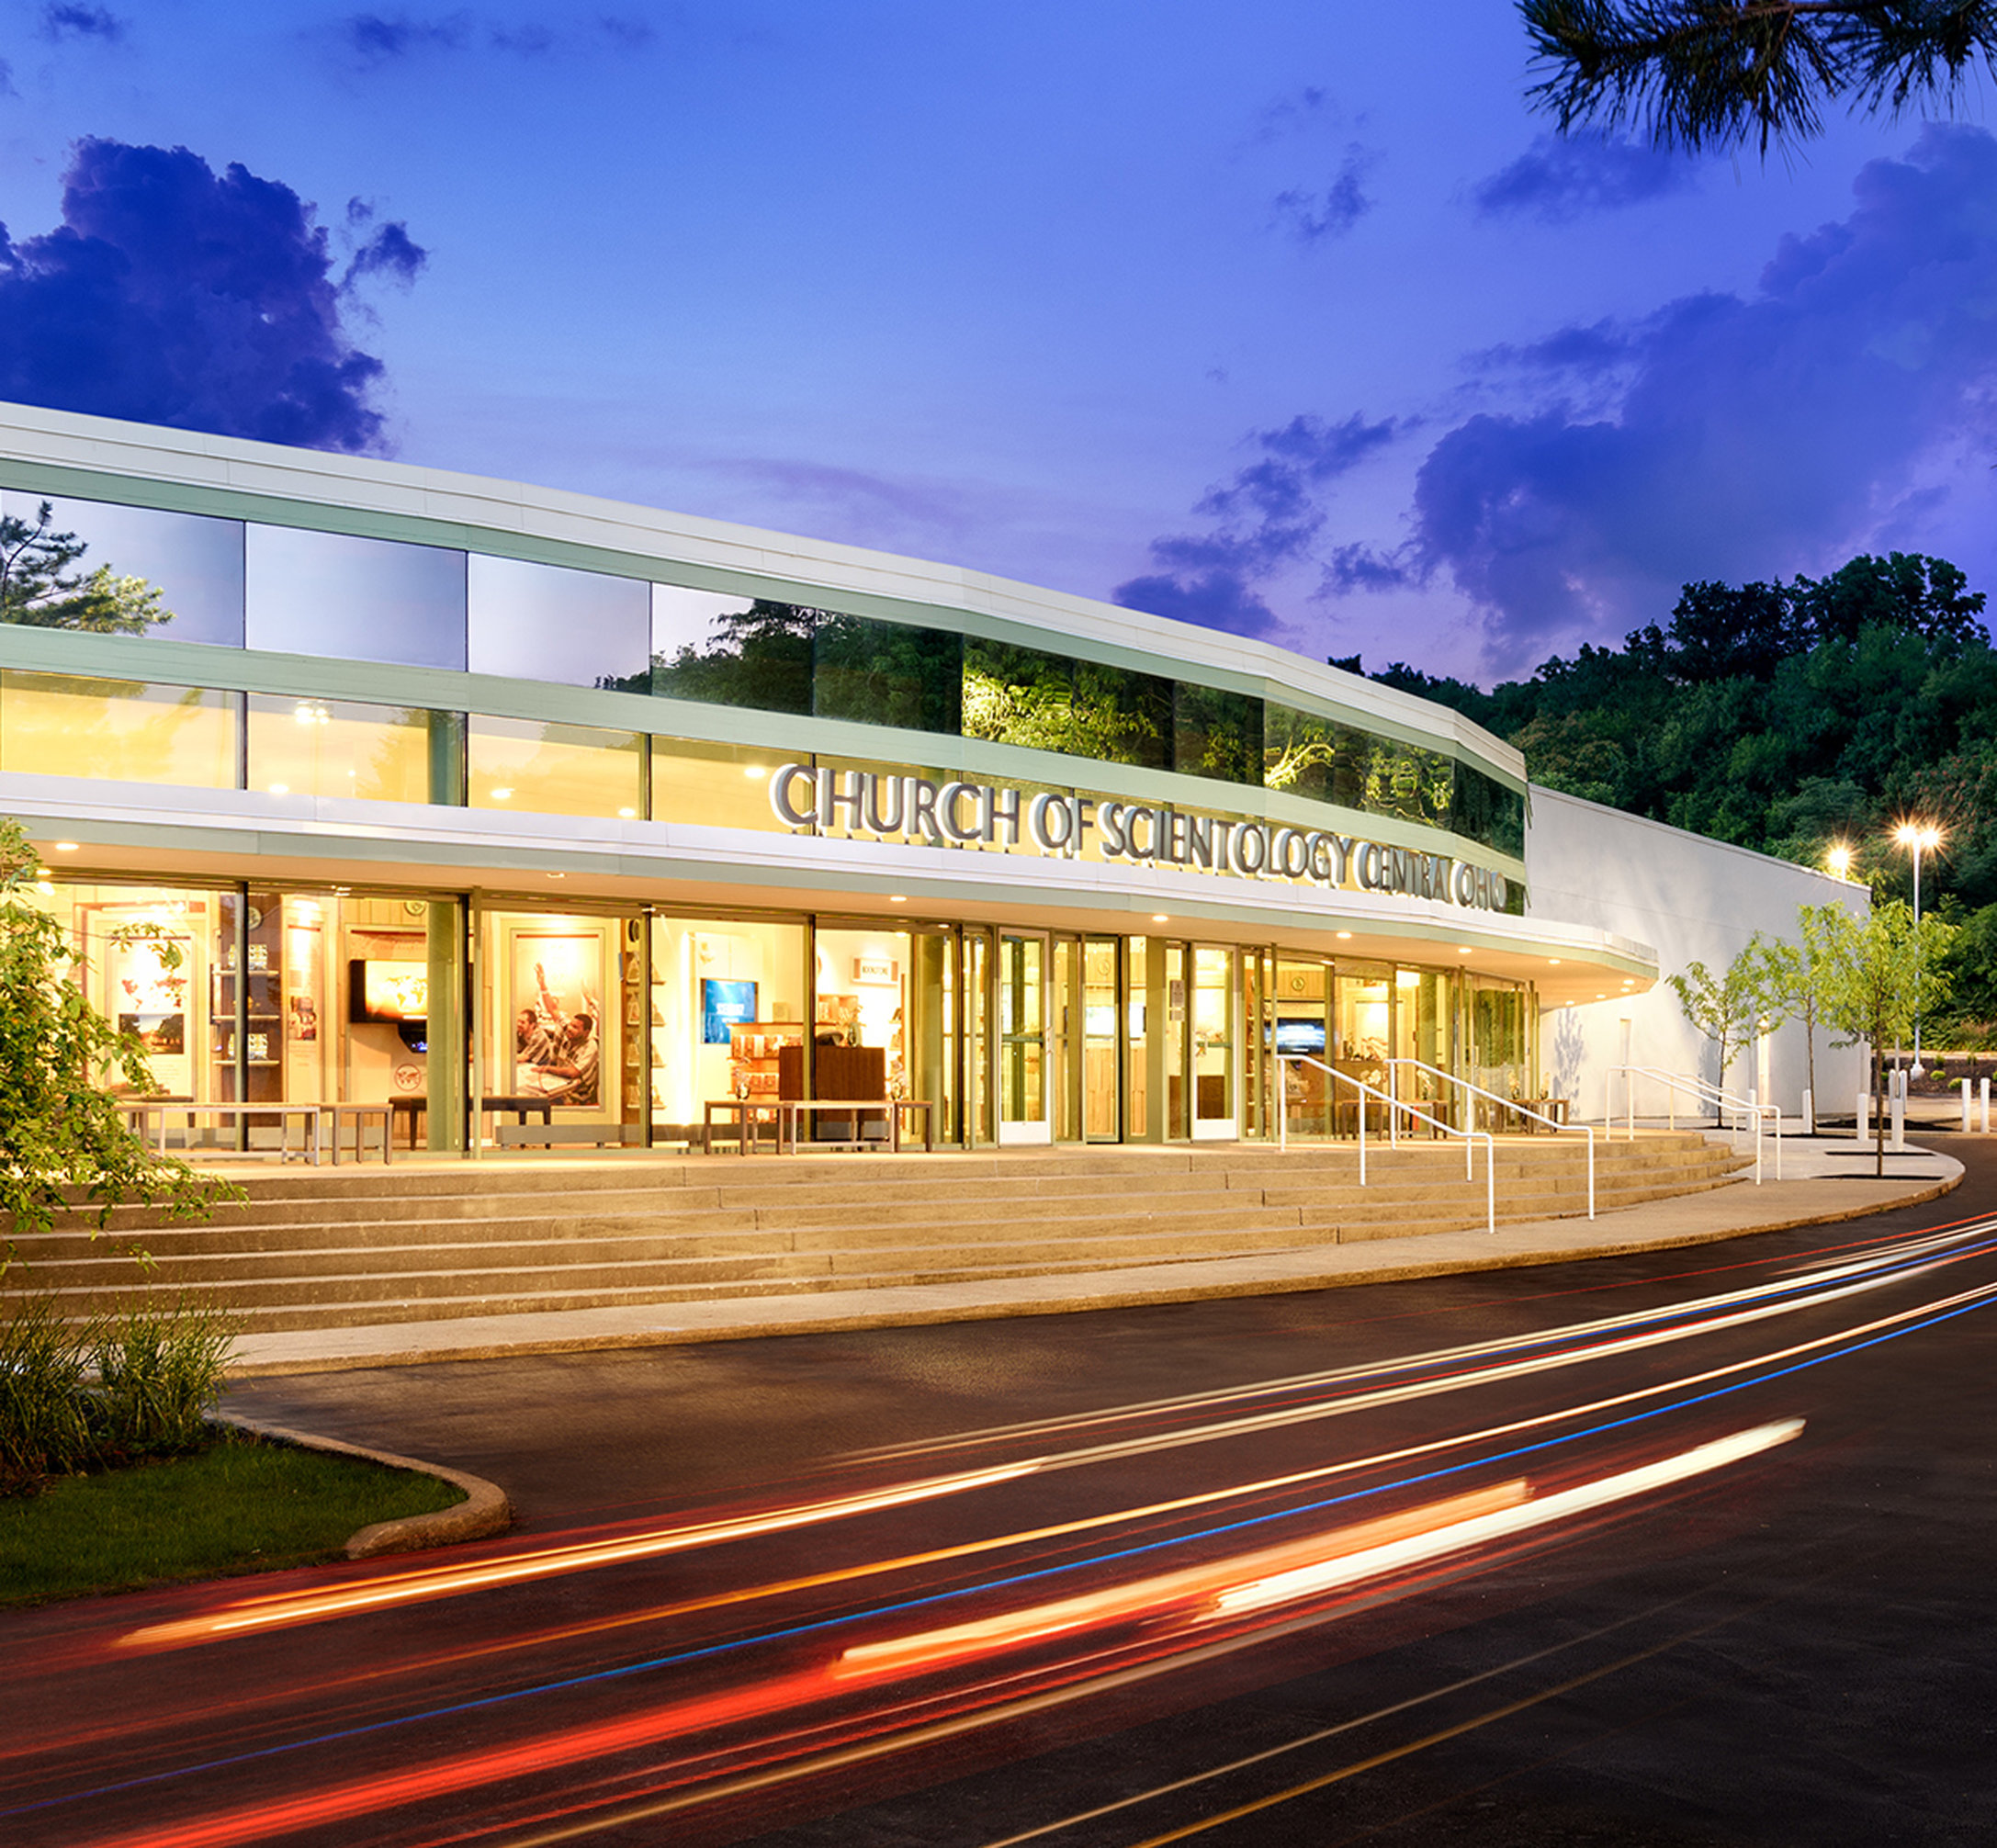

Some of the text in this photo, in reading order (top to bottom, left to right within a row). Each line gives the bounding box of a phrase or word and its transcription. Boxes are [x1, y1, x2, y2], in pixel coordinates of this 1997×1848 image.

[769, 763, 1506, 911] CHURCH OF SCIENTOLOGY CENTRAL OHIO
